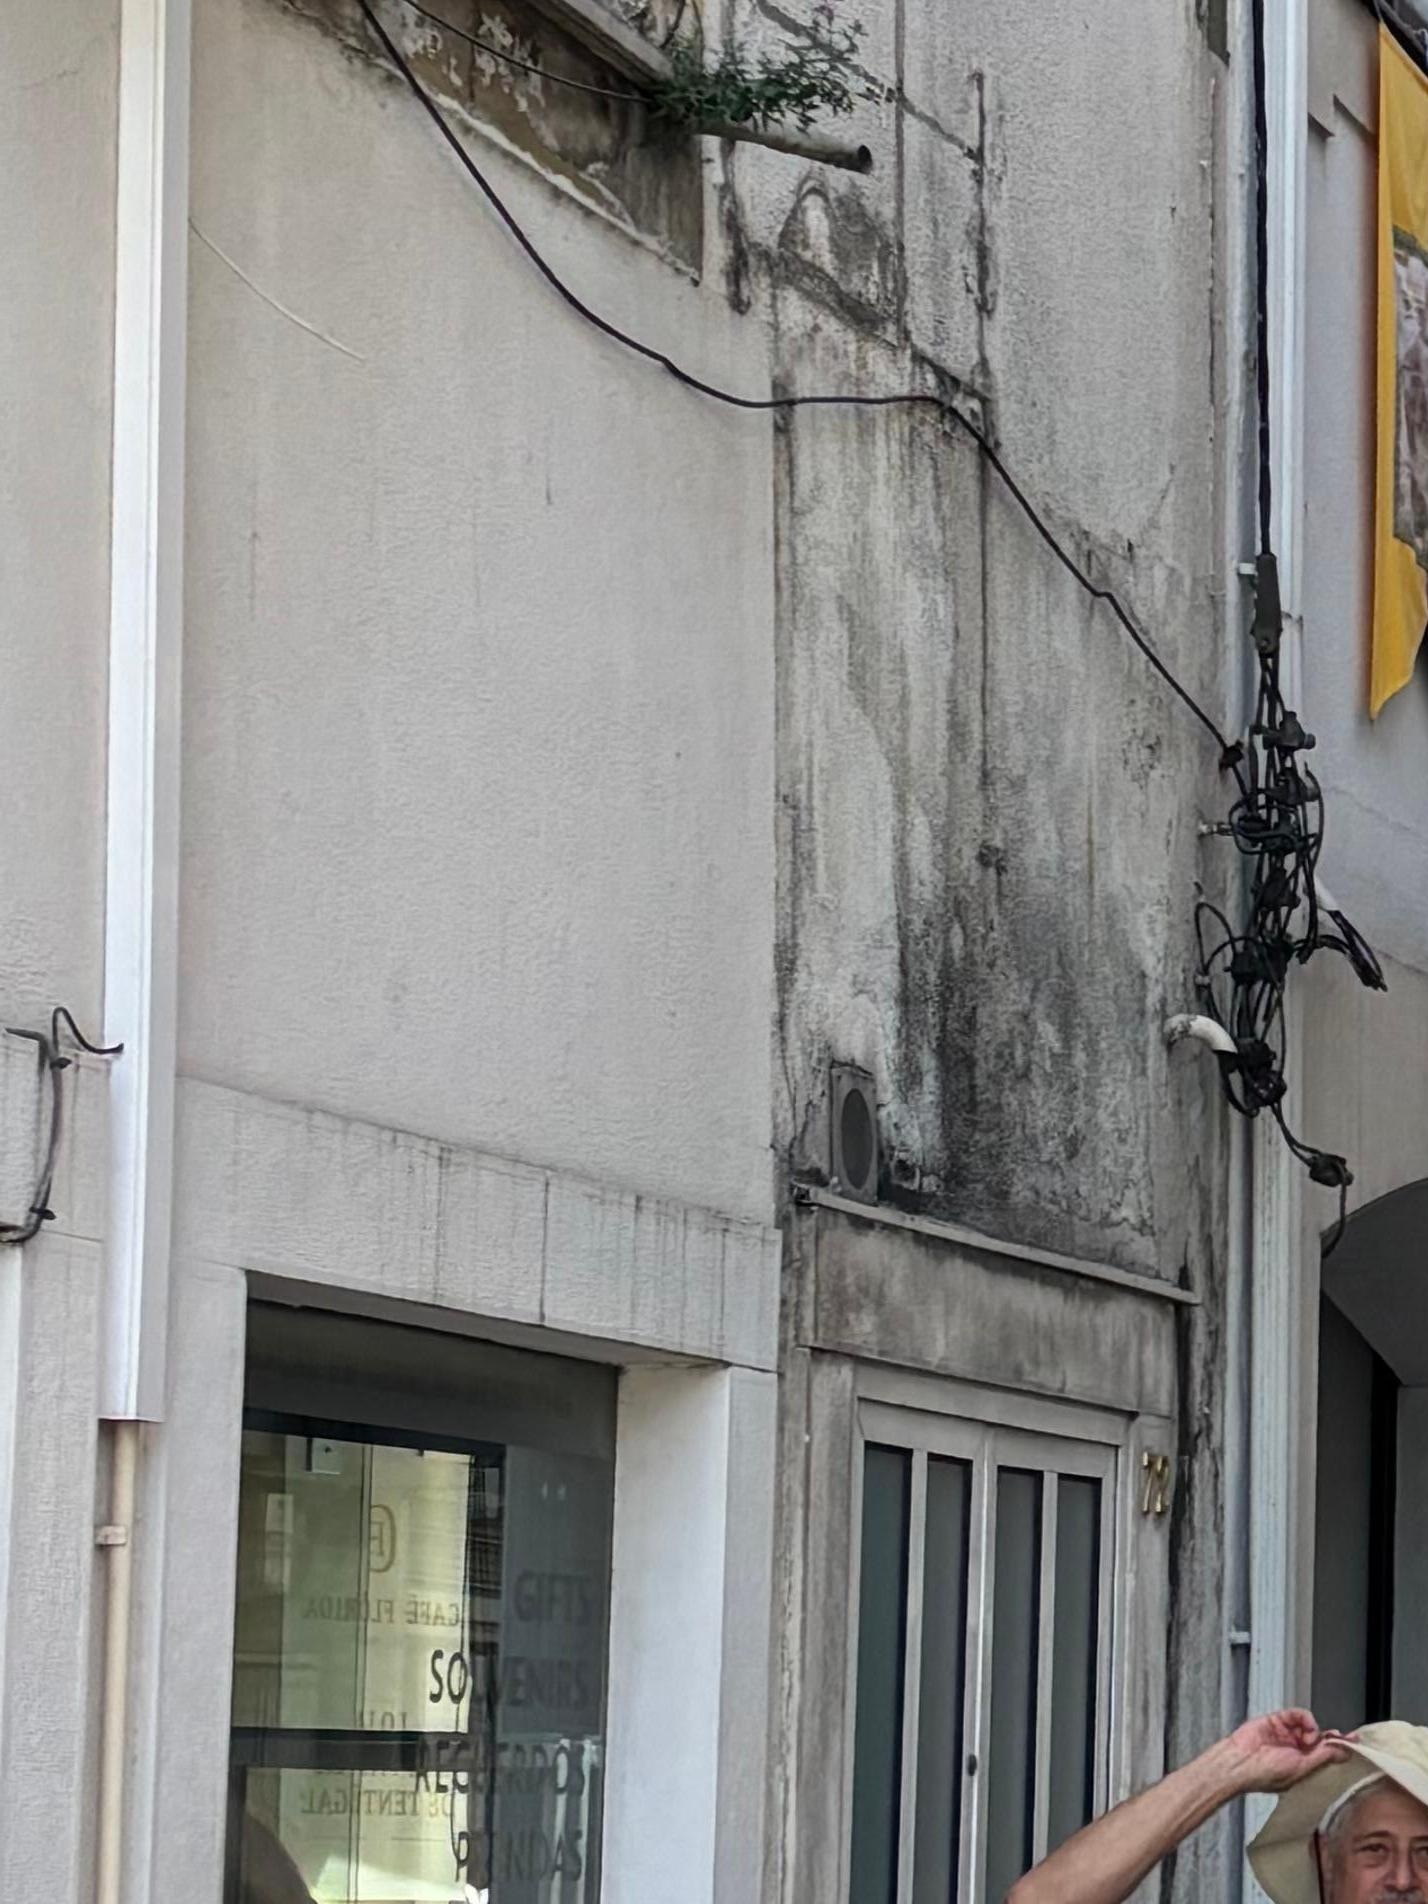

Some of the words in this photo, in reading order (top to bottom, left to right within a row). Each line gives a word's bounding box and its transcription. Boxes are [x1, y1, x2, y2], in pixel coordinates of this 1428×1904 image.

[1142, 1452, 1170, 1513] 72
[512, 1569, 594, 1627] GIFTS
[453, 1828, 583, 1883] PNDAS
